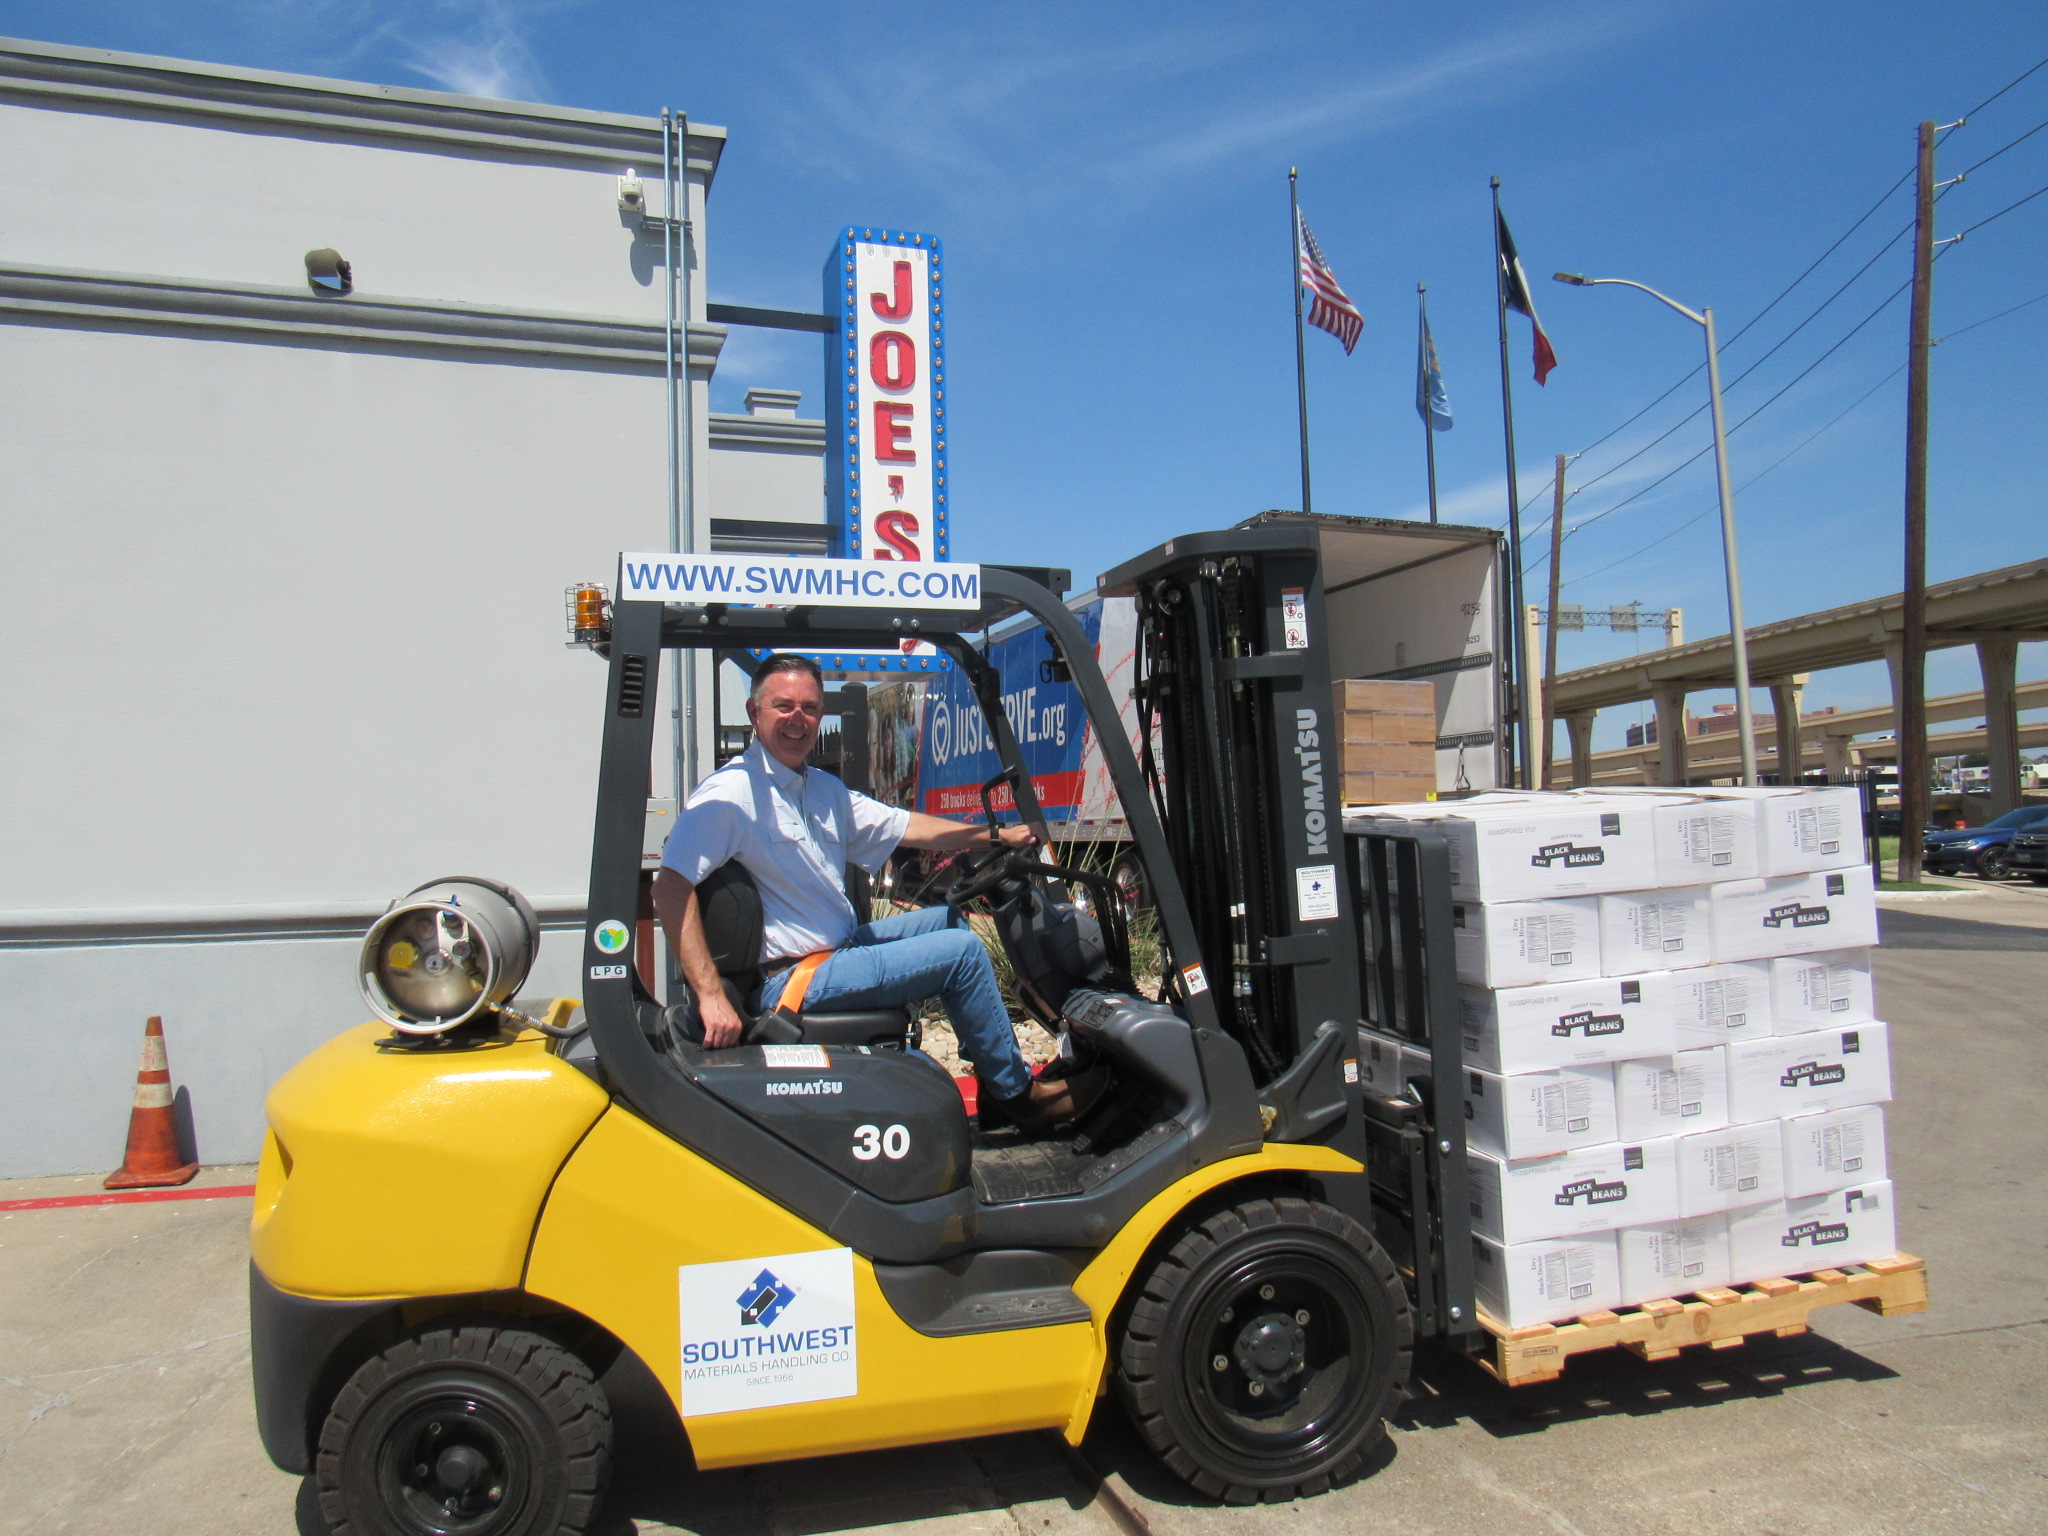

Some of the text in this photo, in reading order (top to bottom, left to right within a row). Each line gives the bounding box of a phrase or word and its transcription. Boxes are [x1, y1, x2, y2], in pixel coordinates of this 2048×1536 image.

[869, 260, 921, 562] JOE'S
[627, 563, 978, 599] WWW.SWMHC.COM
[1466, 635, 1480, 644] 9253
[1294, 709, 1328, 855] KOMATSU
[940, 793, 949, 809] 250
[950, 790, 966, 807] trucks
[998, 786, 1008, 804] 250
[1544, 845, 1570, 857] BLACK
[1569, 852, 1600, 863] BEANS
[1775, 906, 1798, 918] BLACK
[1797, 912, 1826, 923] BEANS
[1564, 1015, 1590, 1026] BLACK
[1589, 1021, 1620, 1032] BEANS
[1792, 1066, 1814, 1077] BLACK
[1813, 1071, 1842, 1082] BEANS
[766, 1079, 843, 1096] KOMATSU
[852, 1124, 910, 1160] 30
[1567, 1183, 1592, 1195] BLACK
[1592, 1187, 1623, 1200] BEANS
[1793, 1225, 1817, 1236] BLACK
[1816, 1229, 1845, 1241] BEANS
[683, 1326, 854, 1364] SOUTHWEST
[684, 1351, 852, 1381] MATERIALS HANDLING CO.
[746, 1372, 794, 1386] SINCE 1966
